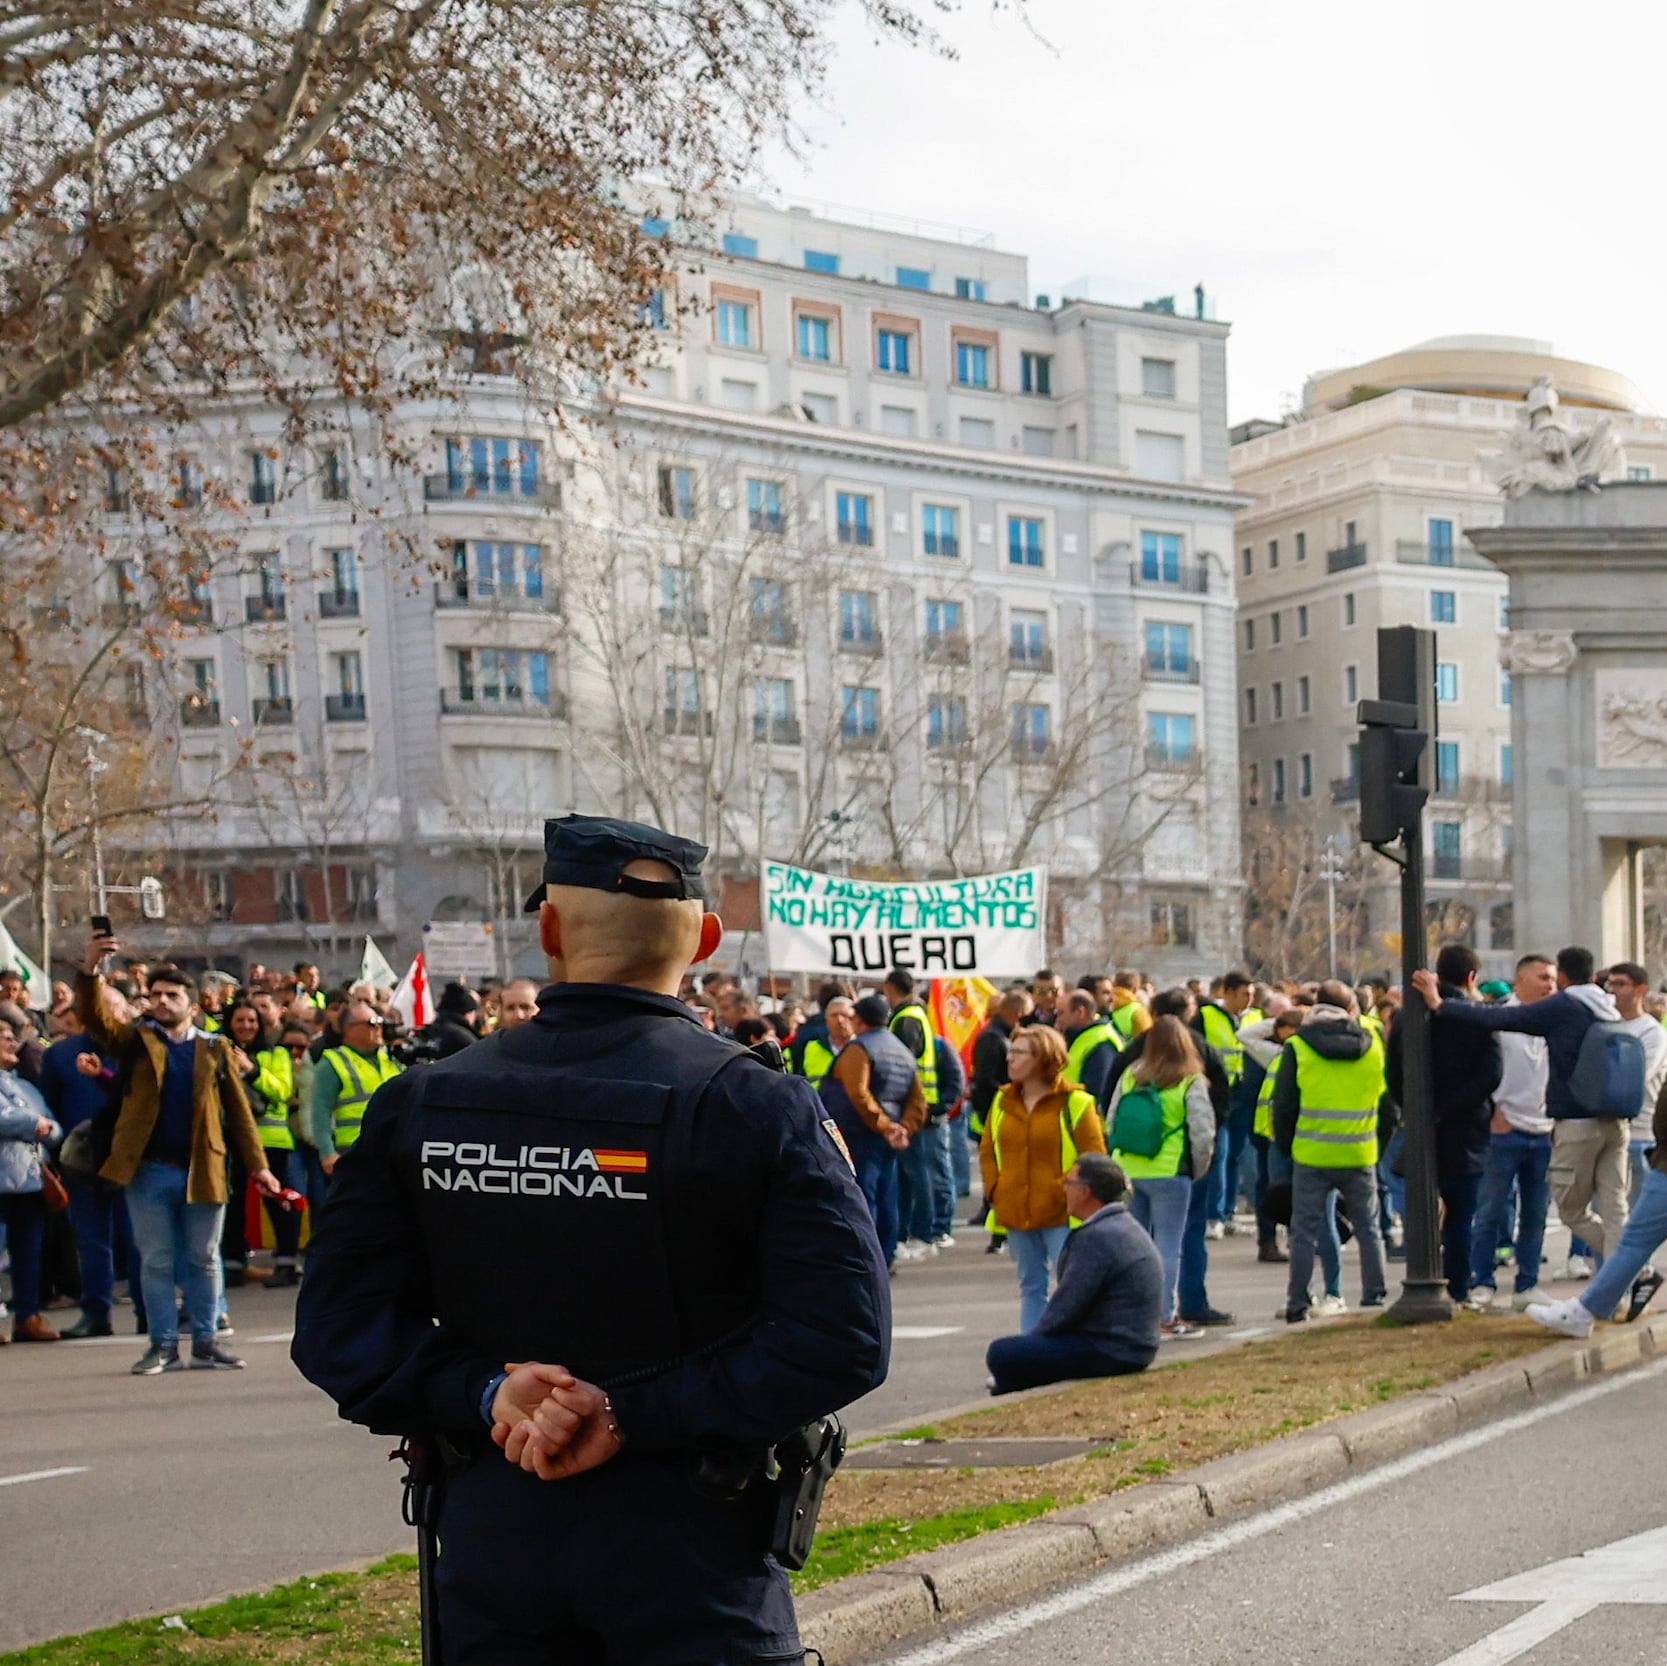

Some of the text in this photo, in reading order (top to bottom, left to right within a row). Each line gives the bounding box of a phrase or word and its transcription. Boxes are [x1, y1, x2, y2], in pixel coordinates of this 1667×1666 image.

[768, 866, 1033, 904] SIN AGRICULTURA
[769, 897, 1037, 930] NO HAY ALIMENTOS
[830, 934, 977, 971] QUERO
[422, 1167, 648, 1200] NACIONAL
